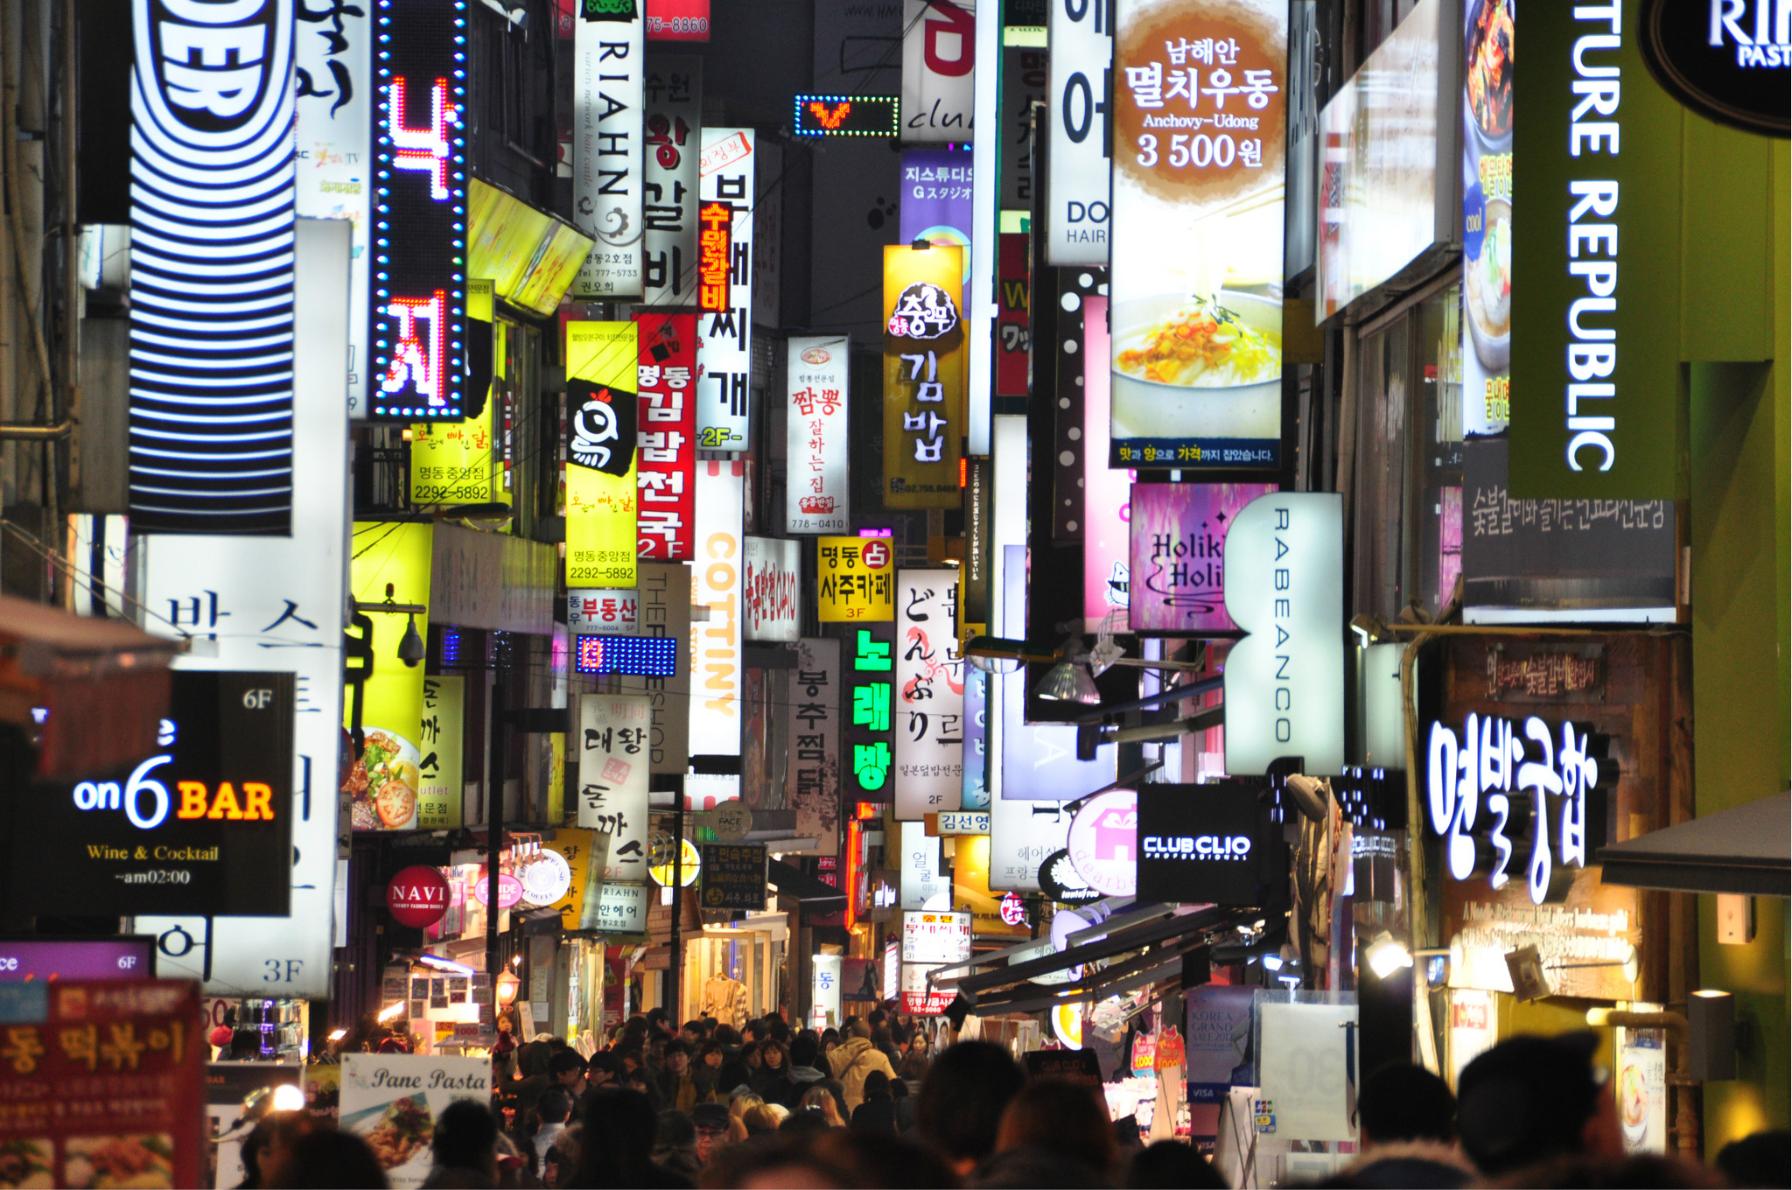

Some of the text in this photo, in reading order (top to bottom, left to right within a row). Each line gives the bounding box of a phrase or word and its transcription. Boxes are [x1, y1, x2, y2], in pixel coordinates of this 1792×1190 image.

[1165, 38, 1241, 64] 남해안
[1124, 62, 1280, 110] 멸치우동
[598, 41, 630, 196] RIAHN
[1142, 114, 1259, 130] Anchovy-Udong
[1565, 180, 1620, 472] REPUBLIC
[792, 386, 843, 416] 짬뽕
[899, 350, 948, 463] 김밥
[637, 391, 685, 541] 김밥천국
[415, 485, 488, 500] 2292-5892
[821, 546, 859, 569] 명동
[1152, 533, 1224, 559] Holik
[569, 566, 634, 579] 2292-5892
[645, 572, 667, 623] THE
[821, 573, 891, 605] 사주카페
[581, 597, 637, 623] 부동산
[845, 608, 866, 617] 3F
[704, 531, 737, 717] COTTINY
[1274, 508, 1291, 743] RABEANCO
[903, 587, 935, 742] どんぶり
[242, 690, 272, 708] 6F
[853, 630, 892, 789] 노래방
[583, 727, 647, 754] 대왕
[176, 780, 275, 820] BAR
[928, 795, 943, 805] 2F
[582, 783, 644, 863] 돈까스
[941, 814, 989, 831] 김선영
[87, 845, 219, 862] Wine & Cocktail
[392, 885, 445, 902] NAVI
[117, 956, 137, 970] 6F
[262, 958, 304, 983] 3F
[1192, 1011, 1233, 1021] KOREA
[370, 1066, 487, 1091] Pane Pasta
[1192, 1089, 1214, 1097] VISA
